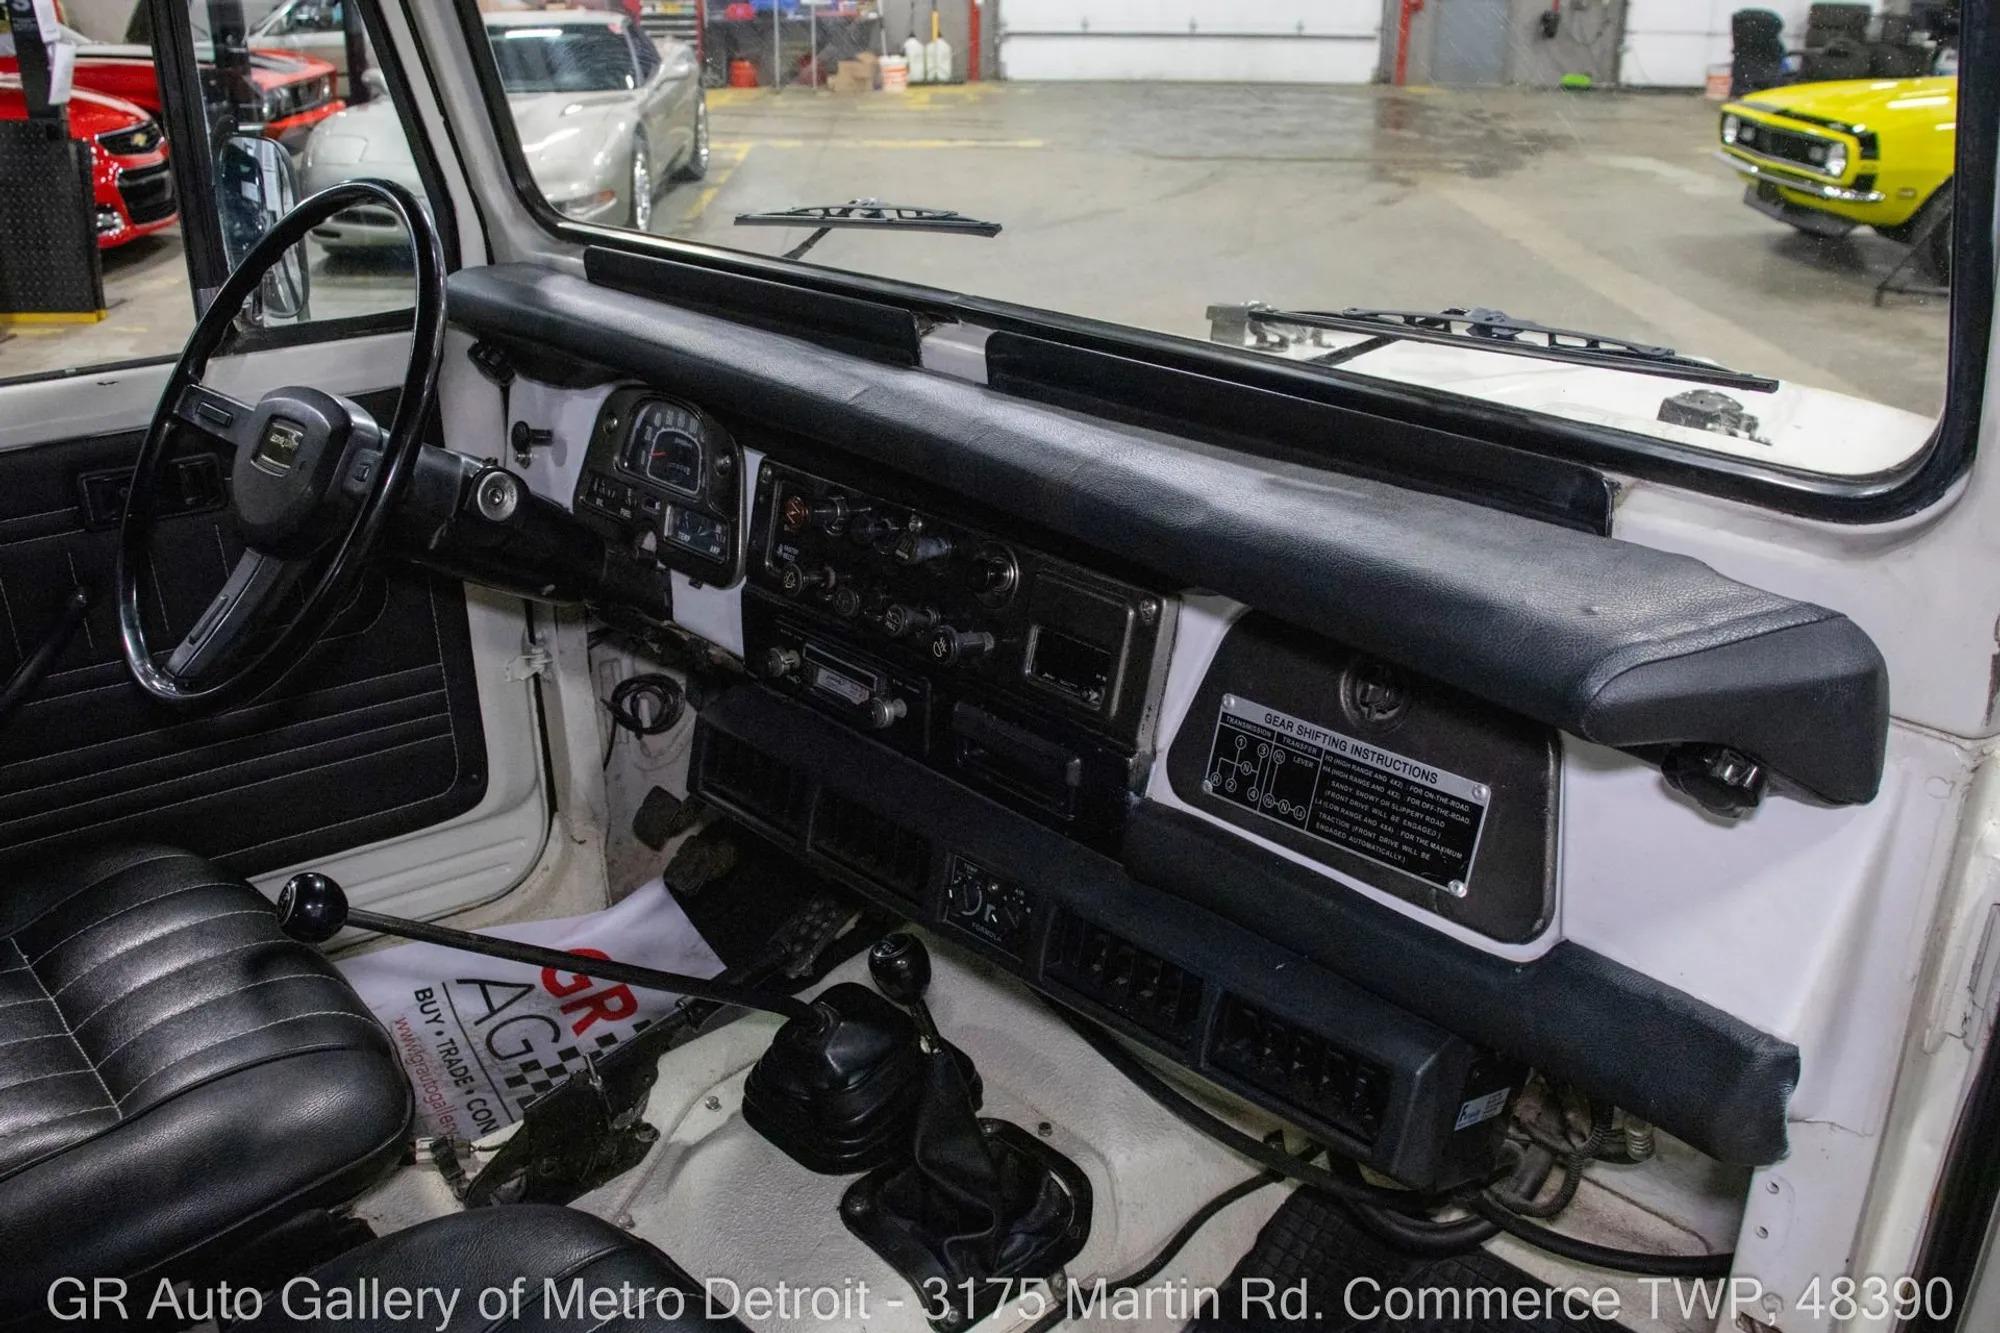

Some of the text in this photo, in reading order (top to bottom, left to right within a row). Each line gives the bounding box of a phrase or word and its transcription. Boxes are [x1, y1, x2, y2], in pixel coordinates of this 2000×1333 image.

[1225, 715, 1271, 737] TRANSMISSION
[1258, 745, 1266, 755] 3
[1263, 712, 1437, 783] GEAR SHIFTING INSTRUCTIONS
[1282, 736, 1317, 754] TRANSFER
[1243, 763, 1250, 772] N
[1292, 755, 1314, 769] LEVER
[1212, 775, 1219, 784] R
[1227, 780, 1234, 789] 2
[1348, 774, 1370, 787] RANGE
[1370, 782, 1385, 793] AND
[1406, 795, 1420, 806] FOR
[1351, 763, 1373, 776] RANGE
[1373, 772, 1388, 782] AND
[1409, 785, 1423, 795] FOR
[1249, 789, 1256, 798] 4
[1281, 802, 1288, 811] N
[1348, 798, 1369, 811] DRIVE
[1369, 806, 1388, 819] WILL
[1389, 813, 1399, 823] BE
[1354, 788, 1378, 803] SNOWY
[1379, 797, 1390, 807] OR
[1390, 802, 1424, 820] SLIPPERY
[1424, 814, 1445, 828] ROAD
[1315, 821, 1346, 839] ENGAGED
[1318, 811, 1349, 829] TRACTION
[1378, 834, 1398, 848] DRIVE
[1401, 843, 1418, 856] WILL
[1420, 850, 1431, 860] BE
[1339, 807, 1362, 821] RANGE
[1363, 816, 1377, 827] AND
[1399, 830, 1414, 841] FOR
[1414, 835, 1429, 846] THE
[1429, 841, 1463, 859] MAXIMUM
[456, 978, 561, 1061] AG
[414, 987, 444, 1025] BUY
[436, 1038, 475, 1088] TRADE
